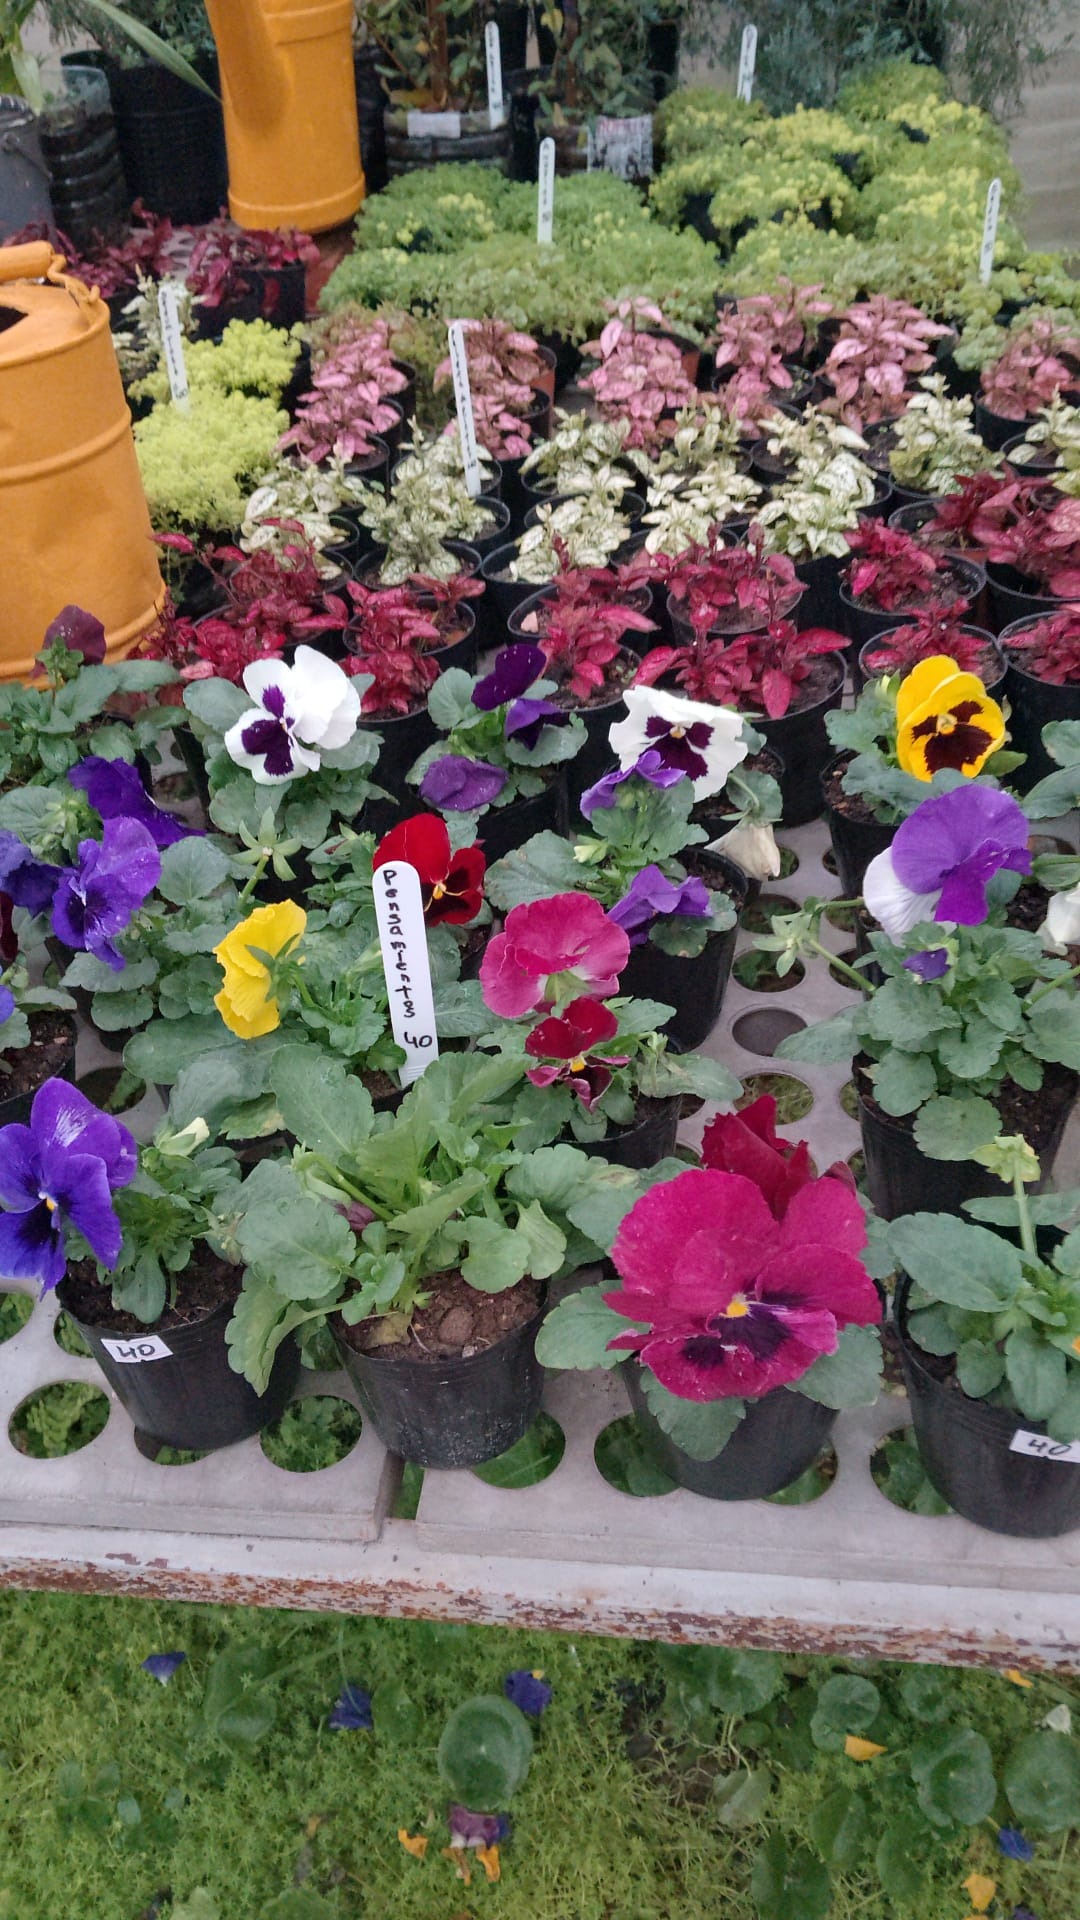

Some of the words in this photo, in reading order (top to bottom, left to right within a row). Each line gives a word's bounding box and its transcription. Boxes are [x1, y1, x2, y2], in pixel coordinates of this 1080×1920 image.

[403, 1031, 433, 1049] 40
[115, 1343, 156, 1359] 40
[1028, 1439, 1072, 1456] 40
